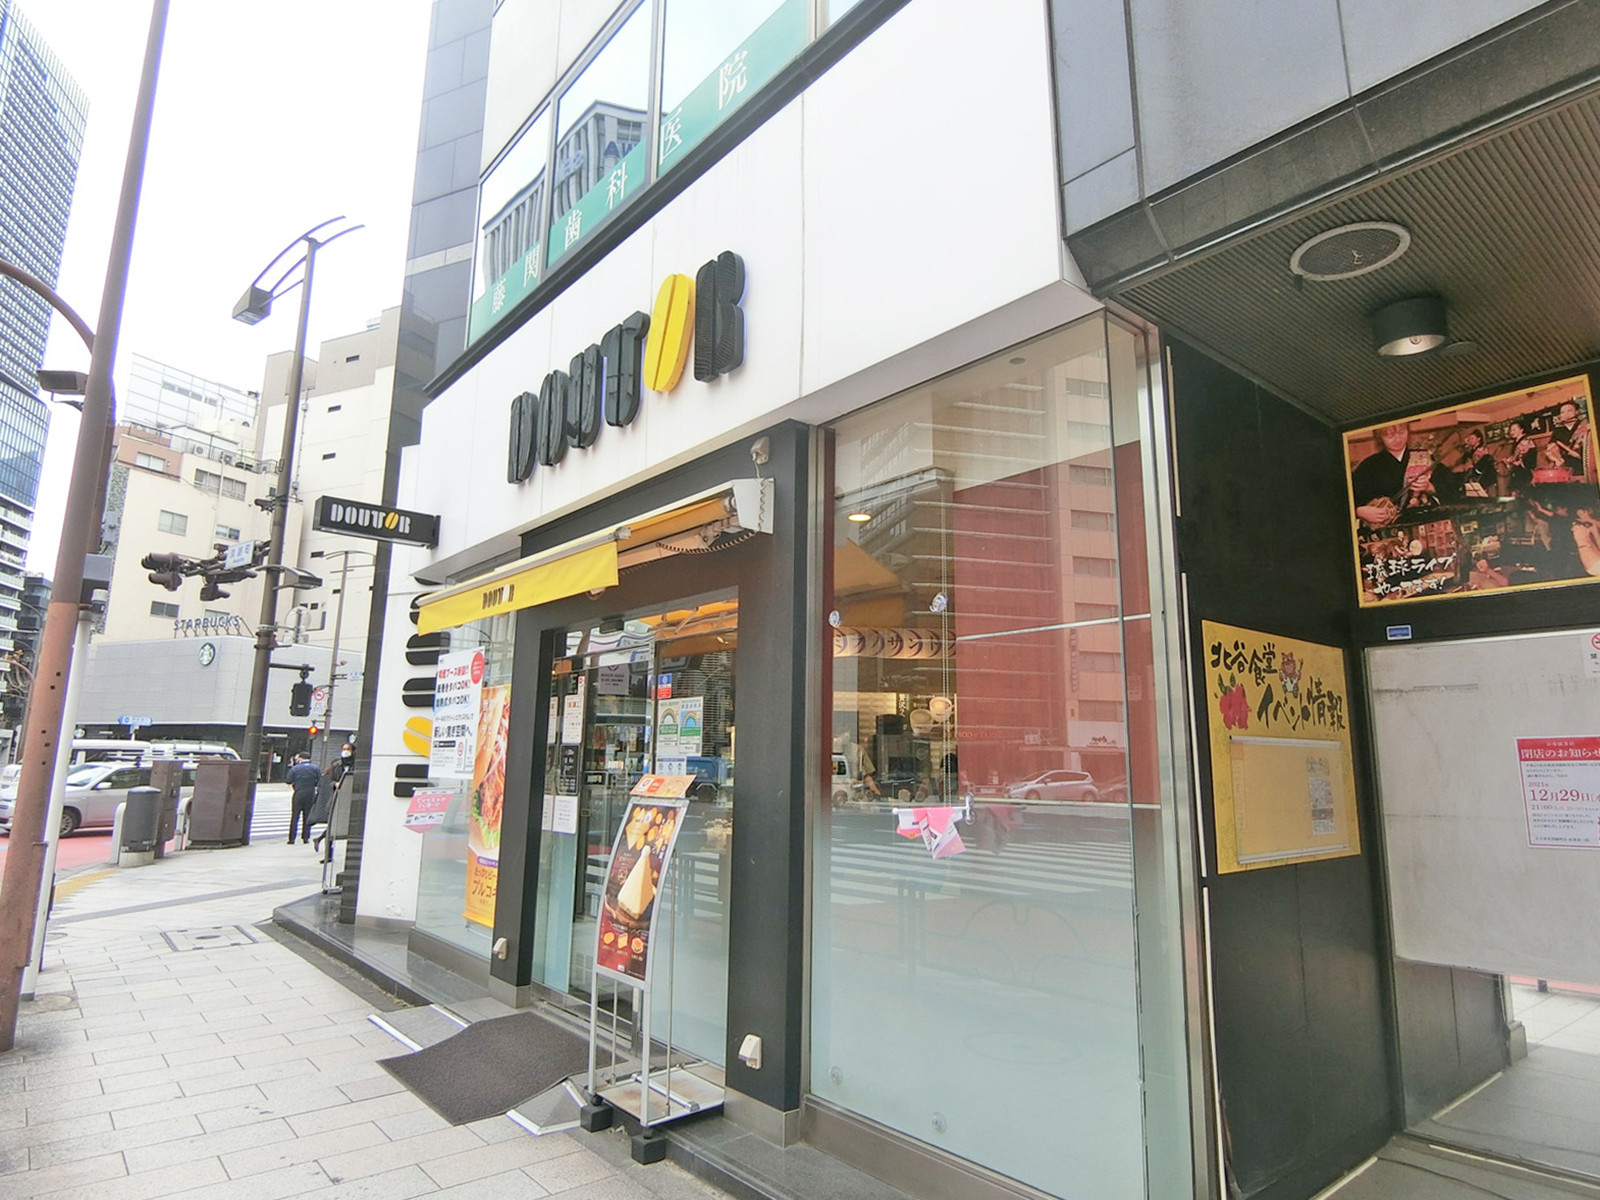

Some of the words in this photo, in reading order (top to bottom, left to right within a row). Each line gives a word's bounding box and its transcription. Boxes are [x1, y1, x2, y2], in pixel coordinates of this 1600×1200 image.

[507, 250, 746, 485] DOUTOR
[330, 503, 411, 534] DOUTOR
[1365, 553, 1457, 580] 琉球ライブ
[482, 584, 515, 609] DOUTOR
[174, 615, 240, 630] STARBUCKS
[1210, 640, 1278, 687] 北谷食堂
[1257, 676, 1346, 733] イベント情報
